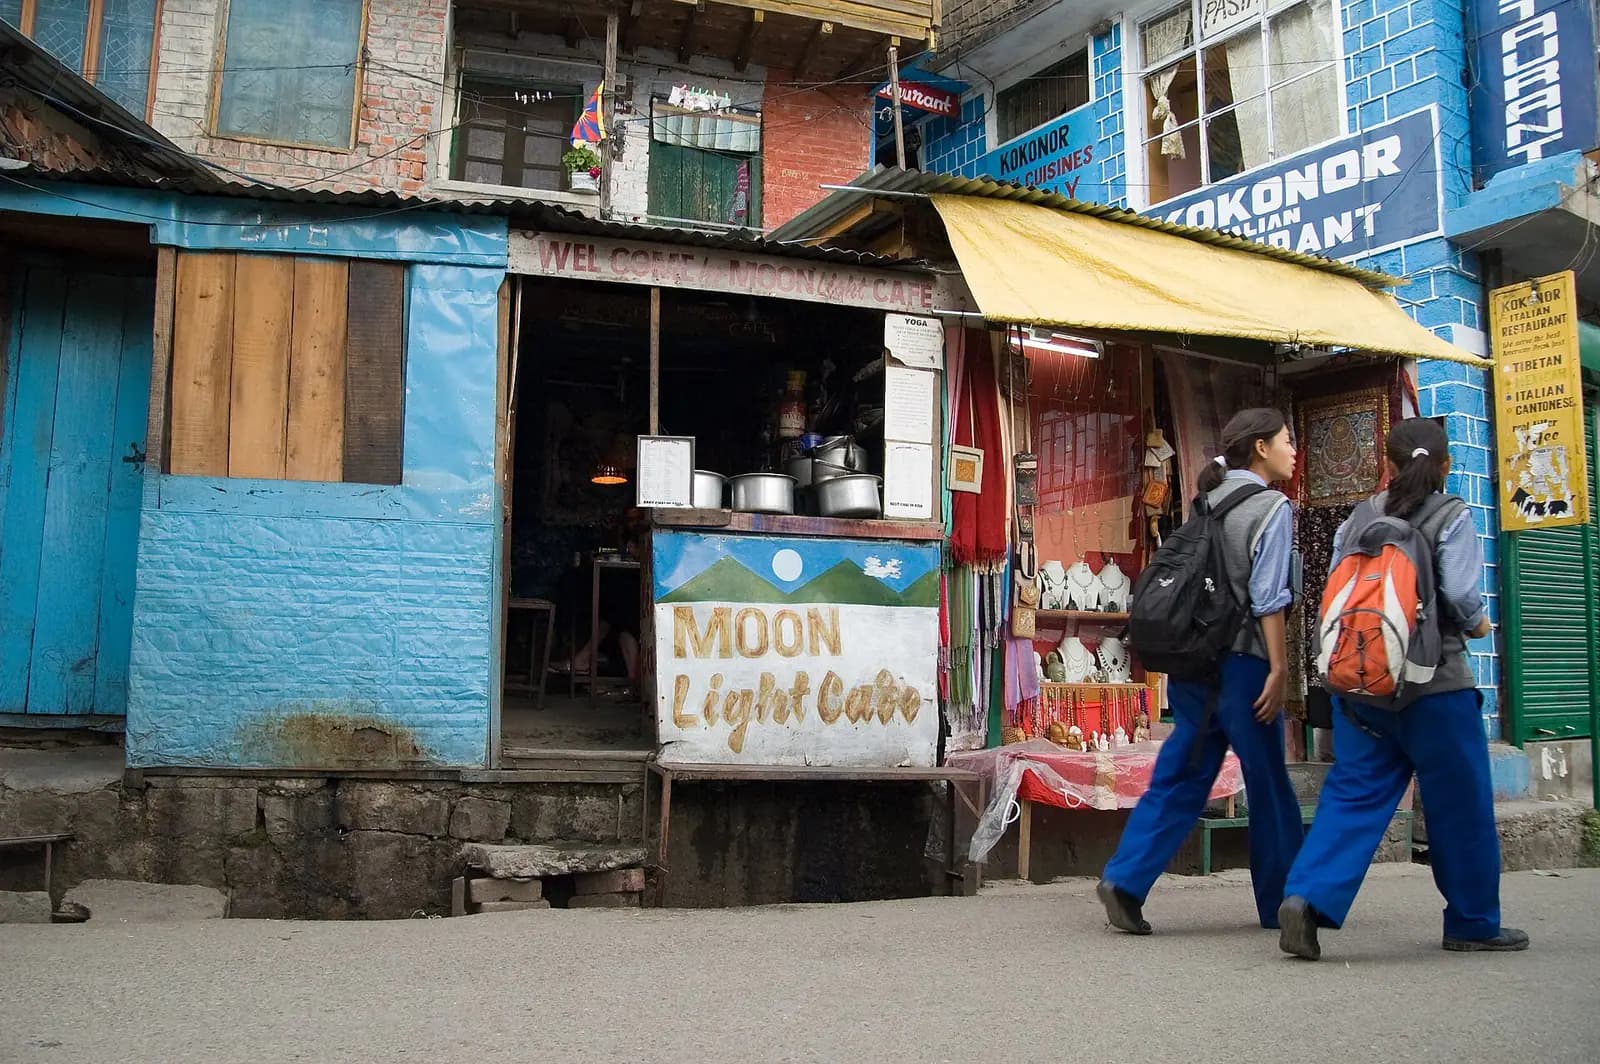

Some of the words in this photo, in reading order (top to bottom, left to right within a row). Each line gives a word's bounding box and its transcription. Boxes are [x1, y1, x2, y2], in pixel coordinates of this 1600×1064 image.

[1498, 0, 1563, 164] TAURANT
[1000, 124, 1069, 177] KOKONOR
[1025, 144, 1093, 187] CUISINES
[728, 259, 816, 295] MOON
[872, 278, 933, 309] CAFE
[1502, 288, 1561, 312] KOKNOR
[904, 318, 928, 327] YOGA
[1502, 313, 1567, 337] RESTAURANT
[1510, 306, 1551, 322] ITALIAN
[1512, 354, 1562, 373] TIBETAN
[1515, 383, 1564, 402] ITALIAN
[1515, 397, 1576, 416] CANTONESE
[673, 605, 843, 659] MOON
[672, 670, 811, 754] Light
